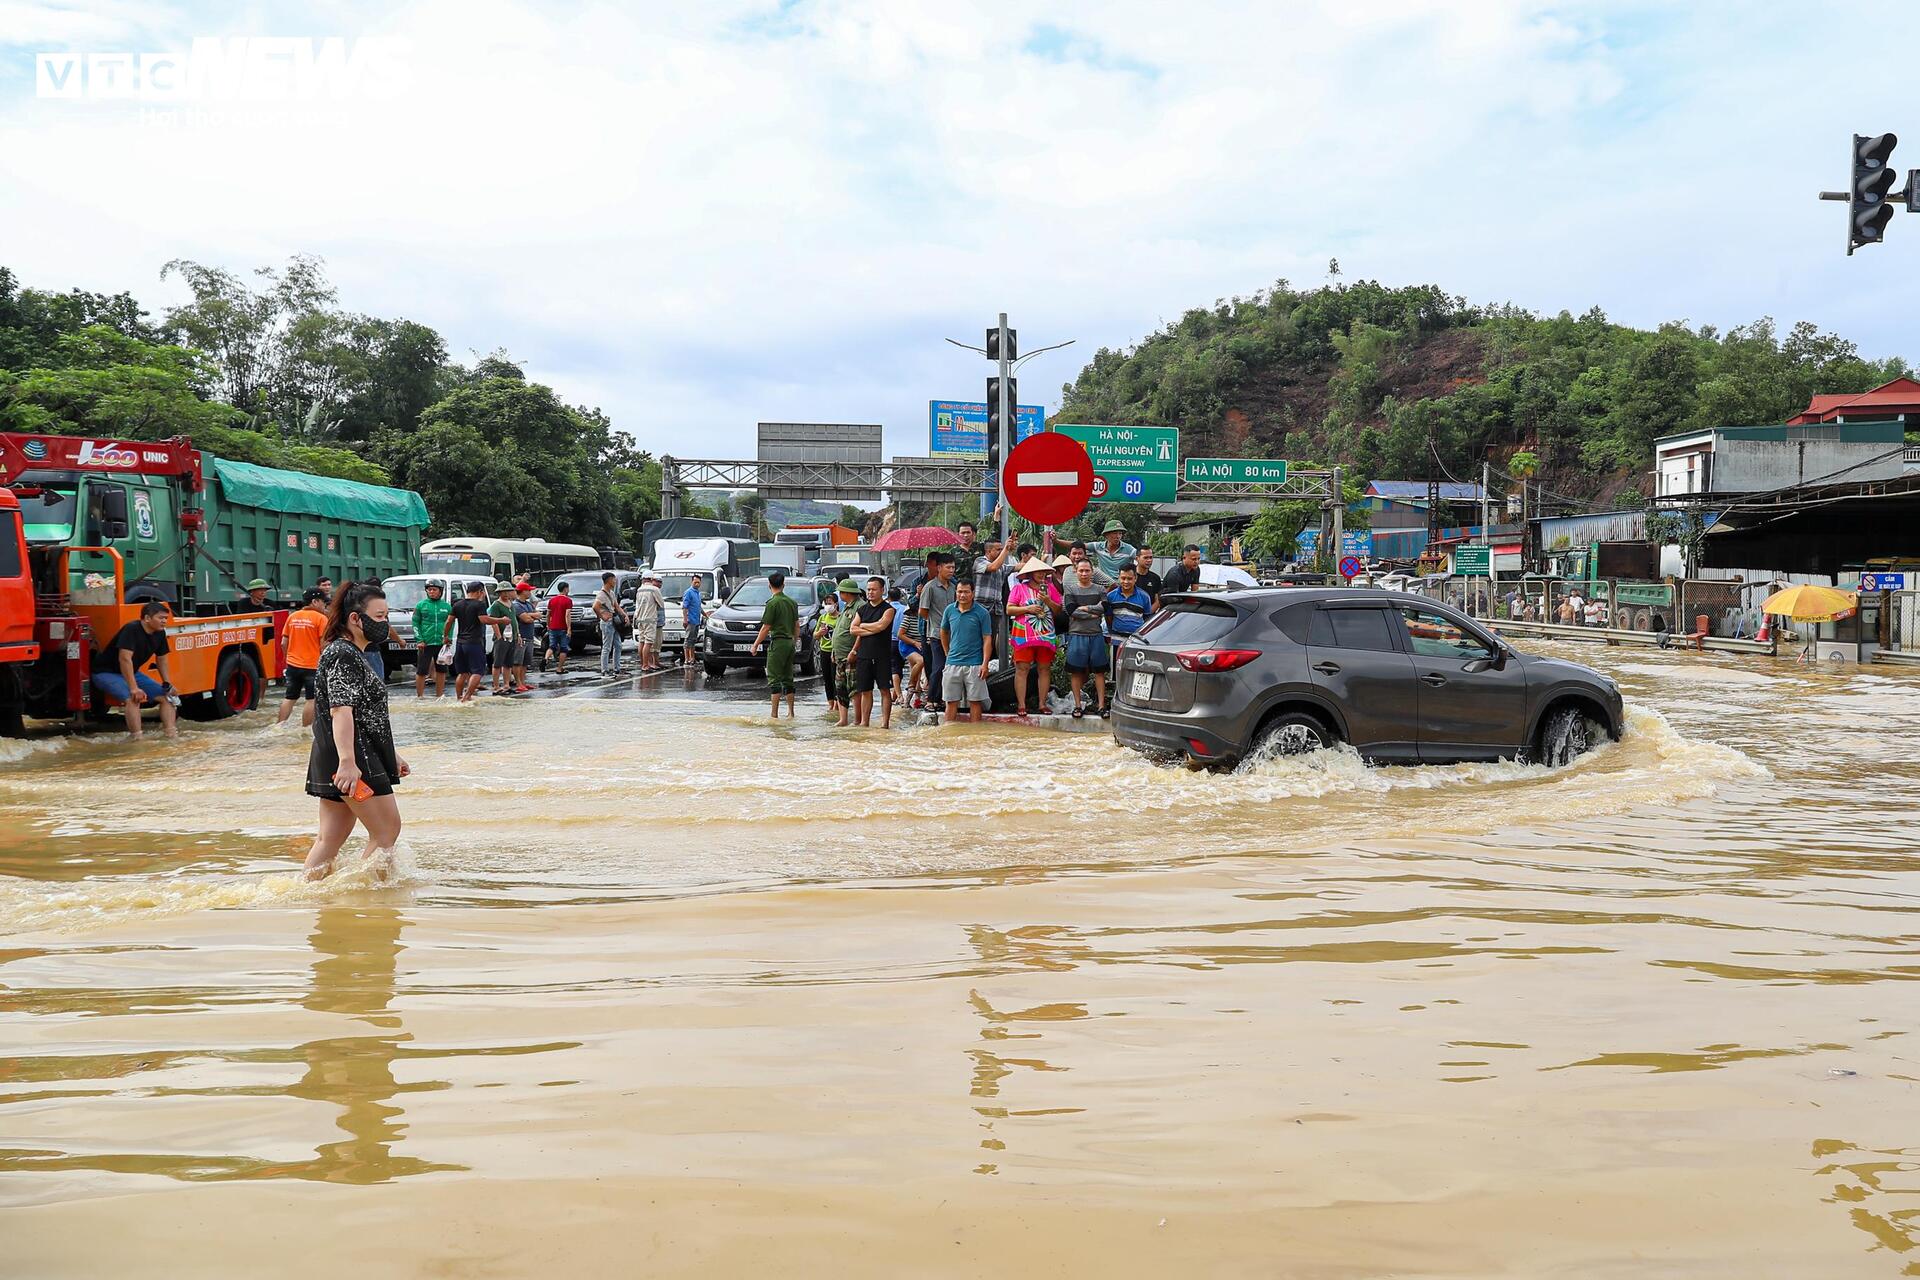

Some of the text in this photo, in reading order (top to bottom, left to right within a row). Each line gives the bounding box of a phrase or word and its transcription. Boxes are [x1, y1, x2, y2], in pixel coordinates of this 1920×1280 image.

[1099, 431, 1113, 440] HÀ
[1090, 444, 1153, 456] THÁI NGUYÊN
[143, 451, 169, 462] UNIC
[1096, 458, 1146, 467] EXPRESSWAY
[1191, 463, 1280, 478] HÀ NỘI 80 km
[1093, 481, 1104, 491] 00
[1125, 480, 1141, 494] 60
[176, 637, 194, 650] GIAO
[195, 632, 219, 648] THÔNG
